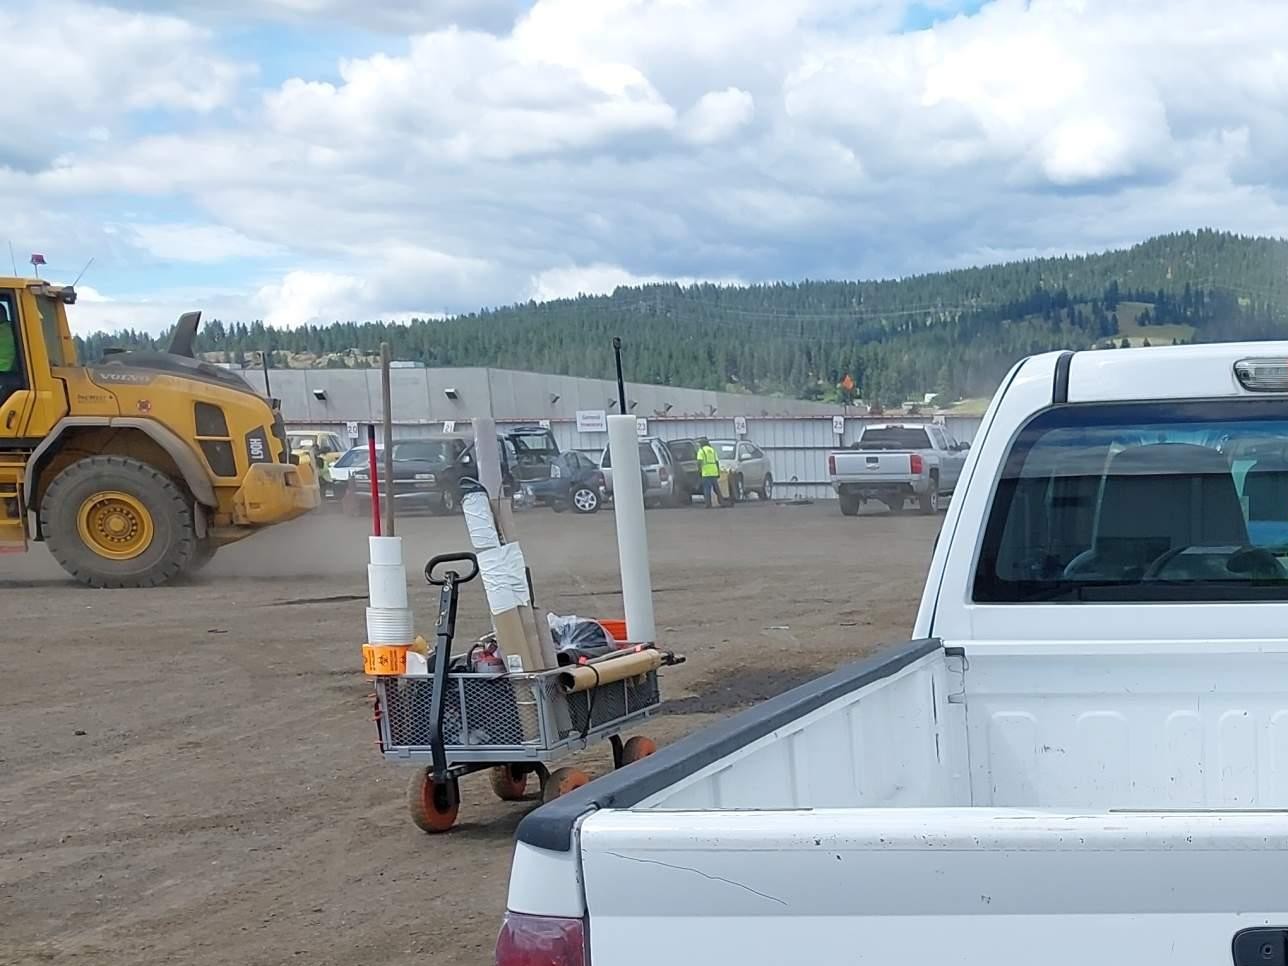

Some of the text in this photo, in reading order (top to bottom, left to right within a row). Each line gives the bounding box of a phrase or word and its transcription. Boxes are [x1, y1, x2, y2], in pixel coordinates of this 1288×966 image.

[100, 373, 151, 382] VOLVO
[736, 422, 746, 431] 24
[249, 438, 264, 459] L90H
